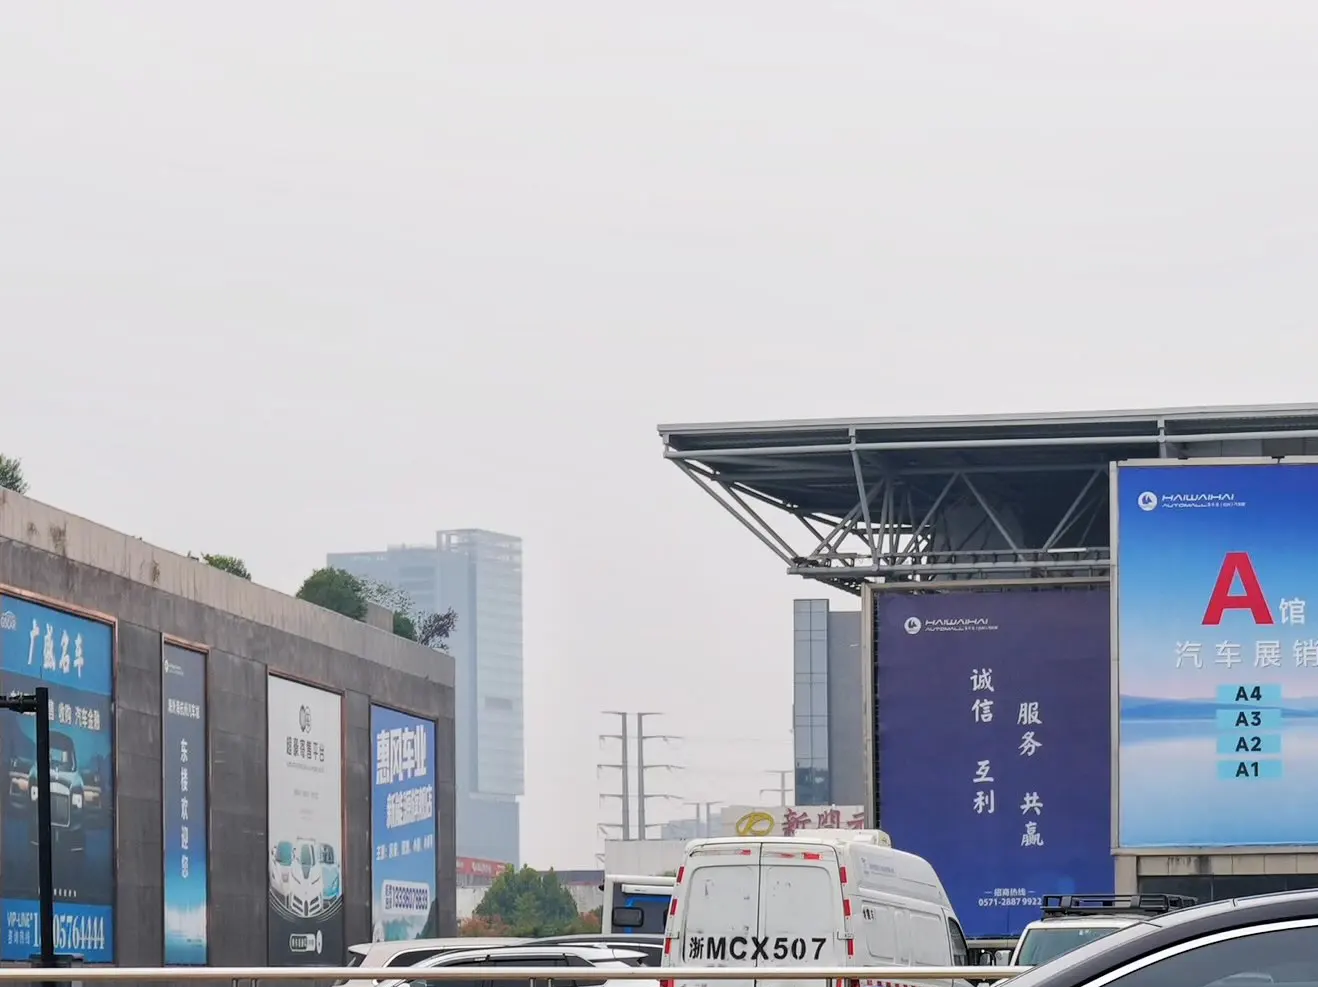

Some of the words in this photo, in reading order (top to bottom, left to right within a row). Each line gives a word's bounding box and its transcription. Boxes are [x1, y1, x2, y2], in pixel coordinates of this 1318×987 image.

[1162, 493, 1234, 501] HAIWAIHAI
[925, 618, 988, 626] HAIWAIHAI
[970, 668, 994, 723] 诚信
[1235, 686, 1262, 702] A4
[1235, 712, 1262, 727] A3
[1017, 702, 1043, 756] 服务
[1235, 737, 1262, 752] A2
[376, 724, 427, 785] 惠风车业
[1235, 762, 1260, 778] A1
[972, 760, 995, 814] 互利
[1020, 792, 1044, 846] 共赢
[1022, 897, 1042, 906] 9922
[33, 911, 105, 950] 105764444
